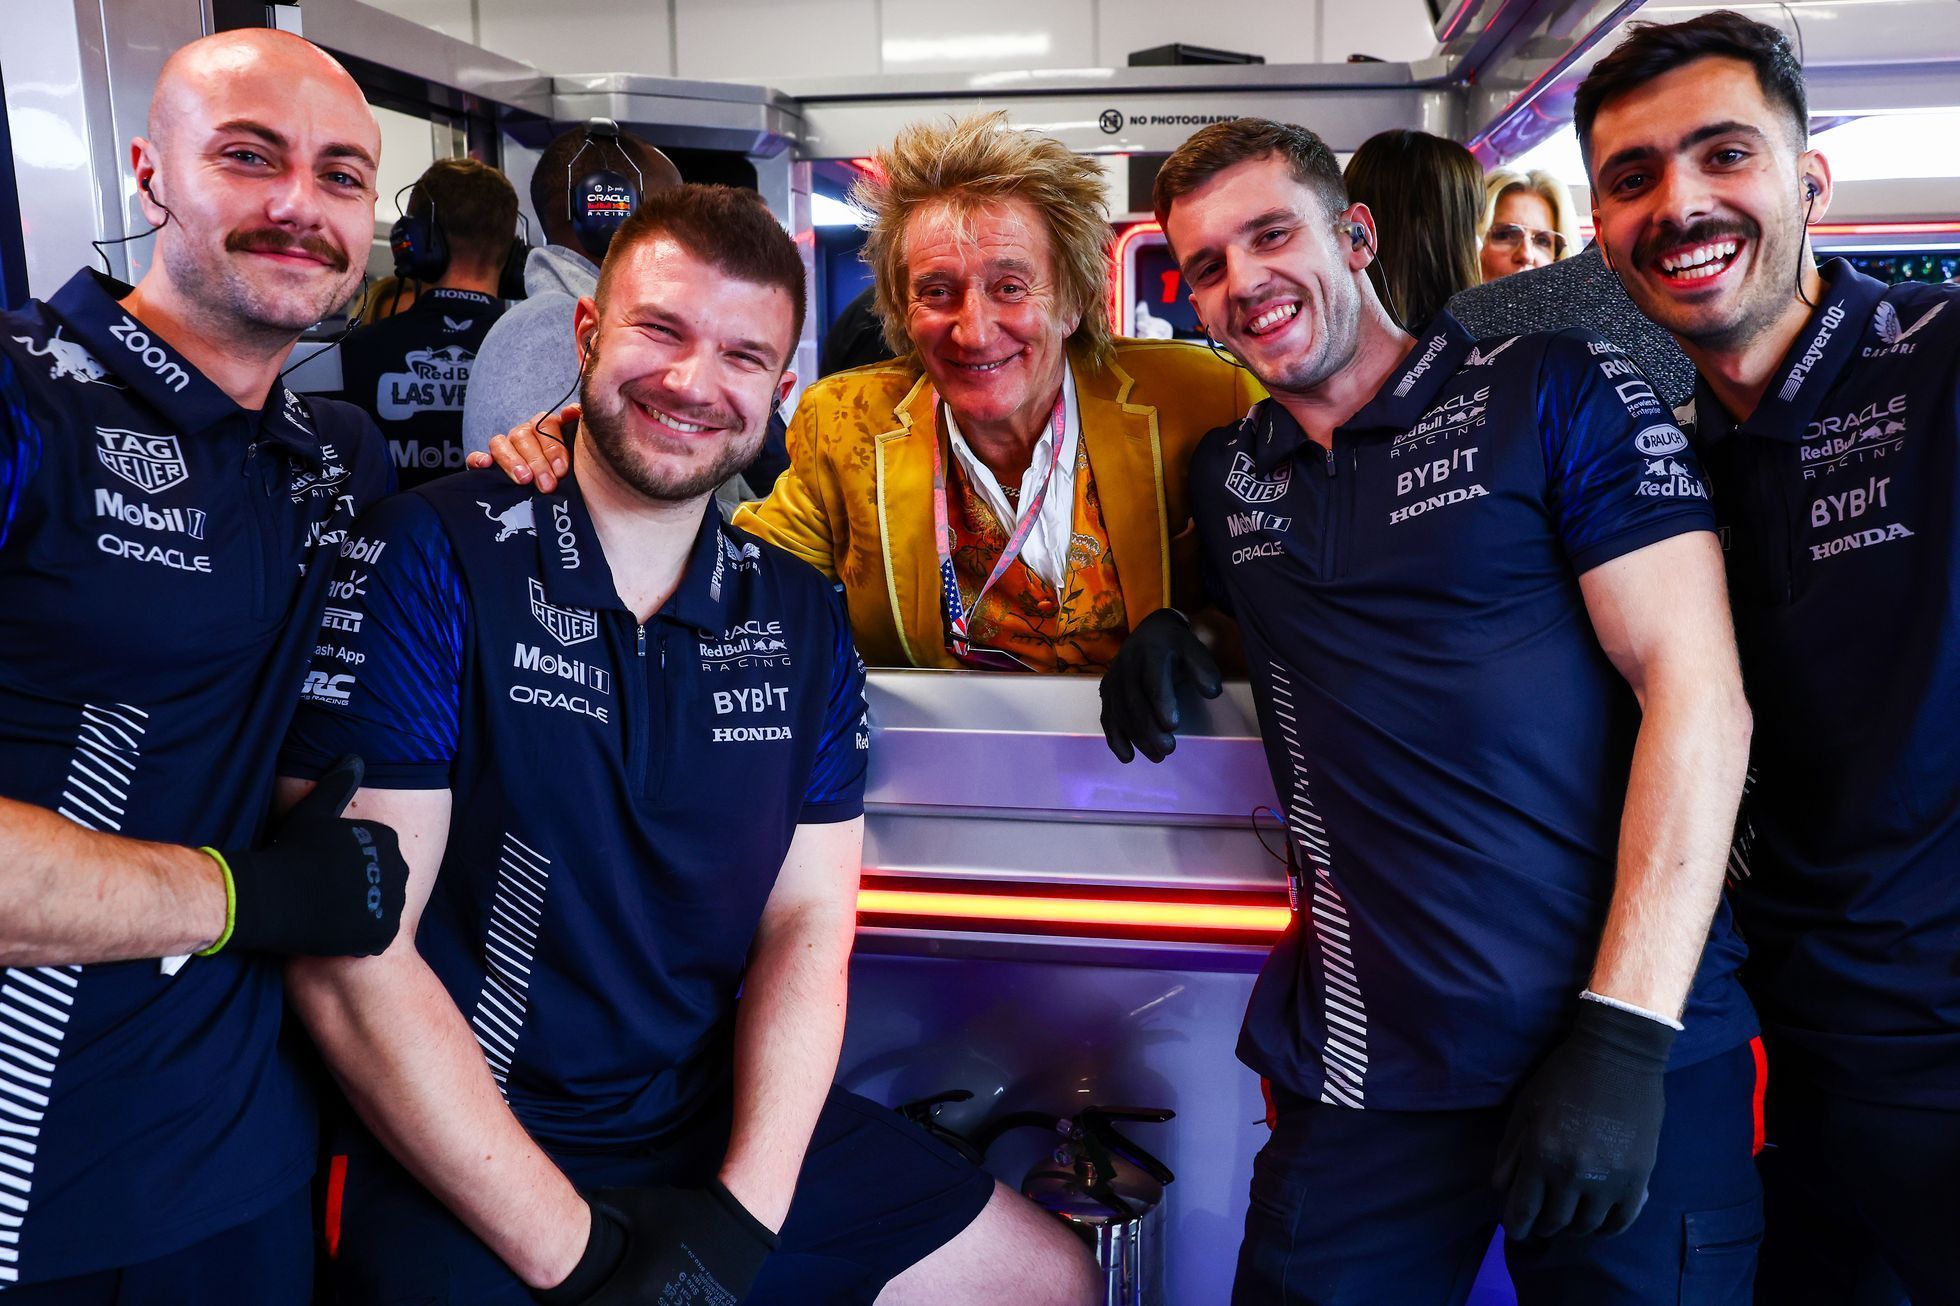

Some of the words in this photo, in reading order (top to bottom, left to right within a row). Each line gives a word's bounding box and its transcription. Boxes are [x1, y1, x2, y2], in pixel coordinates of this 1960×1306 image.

[1129, 115, 1147, 125] NO
[587, 194, 630, 203] ORACLE
[434, 289, 490, 304] HONDA
[109, 316, 190, 392] zoom
[1587, 340, 1625, 356] telc
[1789, 327, 1832, 384] Player
[419, 366, 454, 381] Red
[1401, 346, 1438, 385] Player
[392, 382, 435, 405] LAS
[1421, 385, 1490, 420] ACLE
[1417, 415, 1442, 435] Bull
[1802, 394, 1906, 440] ORACLE
[96, 430, 173, 459] TAG
[1390, 416, 1486, 459] RACING
[1650, 432, 1684, 447] RAUCH
[1799, 441, 1832, 461] Red
[1833, 430, 1857, 453] Bull
[388, 440, 466, 469] Mob
[1240, 456, 1288, 481] TG
[1803, 440, 1904, 480] RACING
[102, 452, 181, 489] HEUER
[1396, 448, 1479, 496] BYBIT
[1229, 474, 1286, 501] HEUER
[1635, 476, 1674, 496] Red
[1678, 477, 1709, 500] Bull
[95, 488, 185, 533] Mobil
[1389, 483, 1490, 526] HONDA
[1811, 477, 1891, 528] BYBIT
[552, 500, 581, 570] zoom
[1226, 510, 1265, 538] Mobil
[97, 534, 212, 573] ORACLE
[340, 536, 387, 565] obil
[1231, 541, 1285, 565] ORACLE
[1809, 523, 1915, 561] HONDA
[534, 604, 593, 640] HEUER
[698, 620, 783, 641] ACLE
[315, 643, 335, 657] ash
[335, 647, 366, 666] App
[699, 642, 724, 657] Red
[723, 638, 751, 656] Bull
[513, 642, 586, 685] Mobil
[702, 657, 792, 672] RACING
[311, 695, 350, 706] RACING
[509, 685, 609, 724] ORACLE
[713, 682, 789, 714] BYBIT
[712, 726, 793, 742] HONDA
